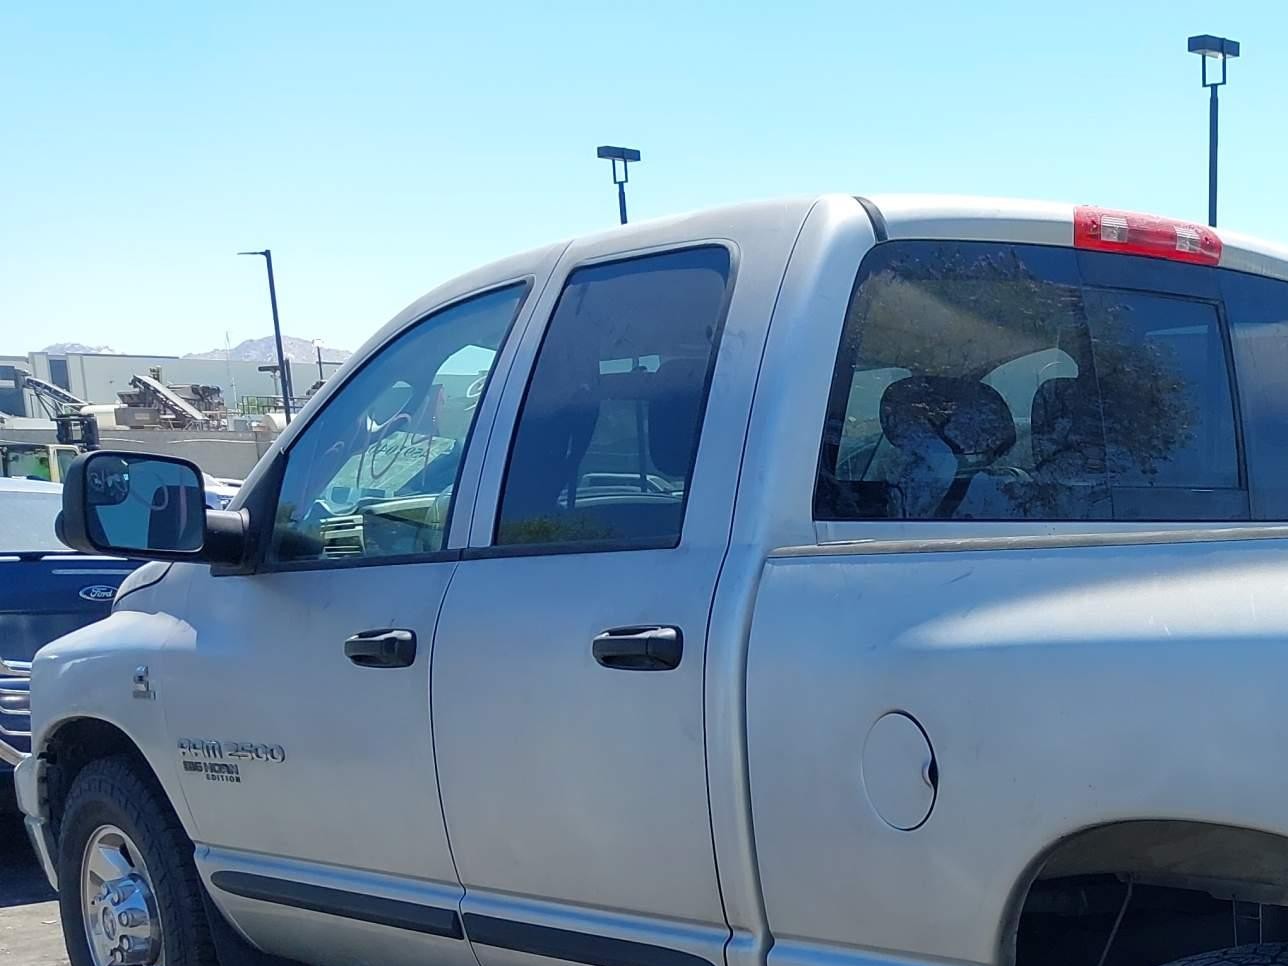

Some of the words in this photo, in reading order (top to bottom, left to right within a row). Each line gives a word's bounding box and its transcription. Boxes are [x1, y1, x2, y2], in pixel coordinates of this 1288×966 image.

[90, 587, 113, 598] Ford
[177, 738, 223, 759] RAM
[225, 742, 286, 763] 2500
[203, 762, 239, 775] HORN
[206, 773, 241, 783] EDITION
